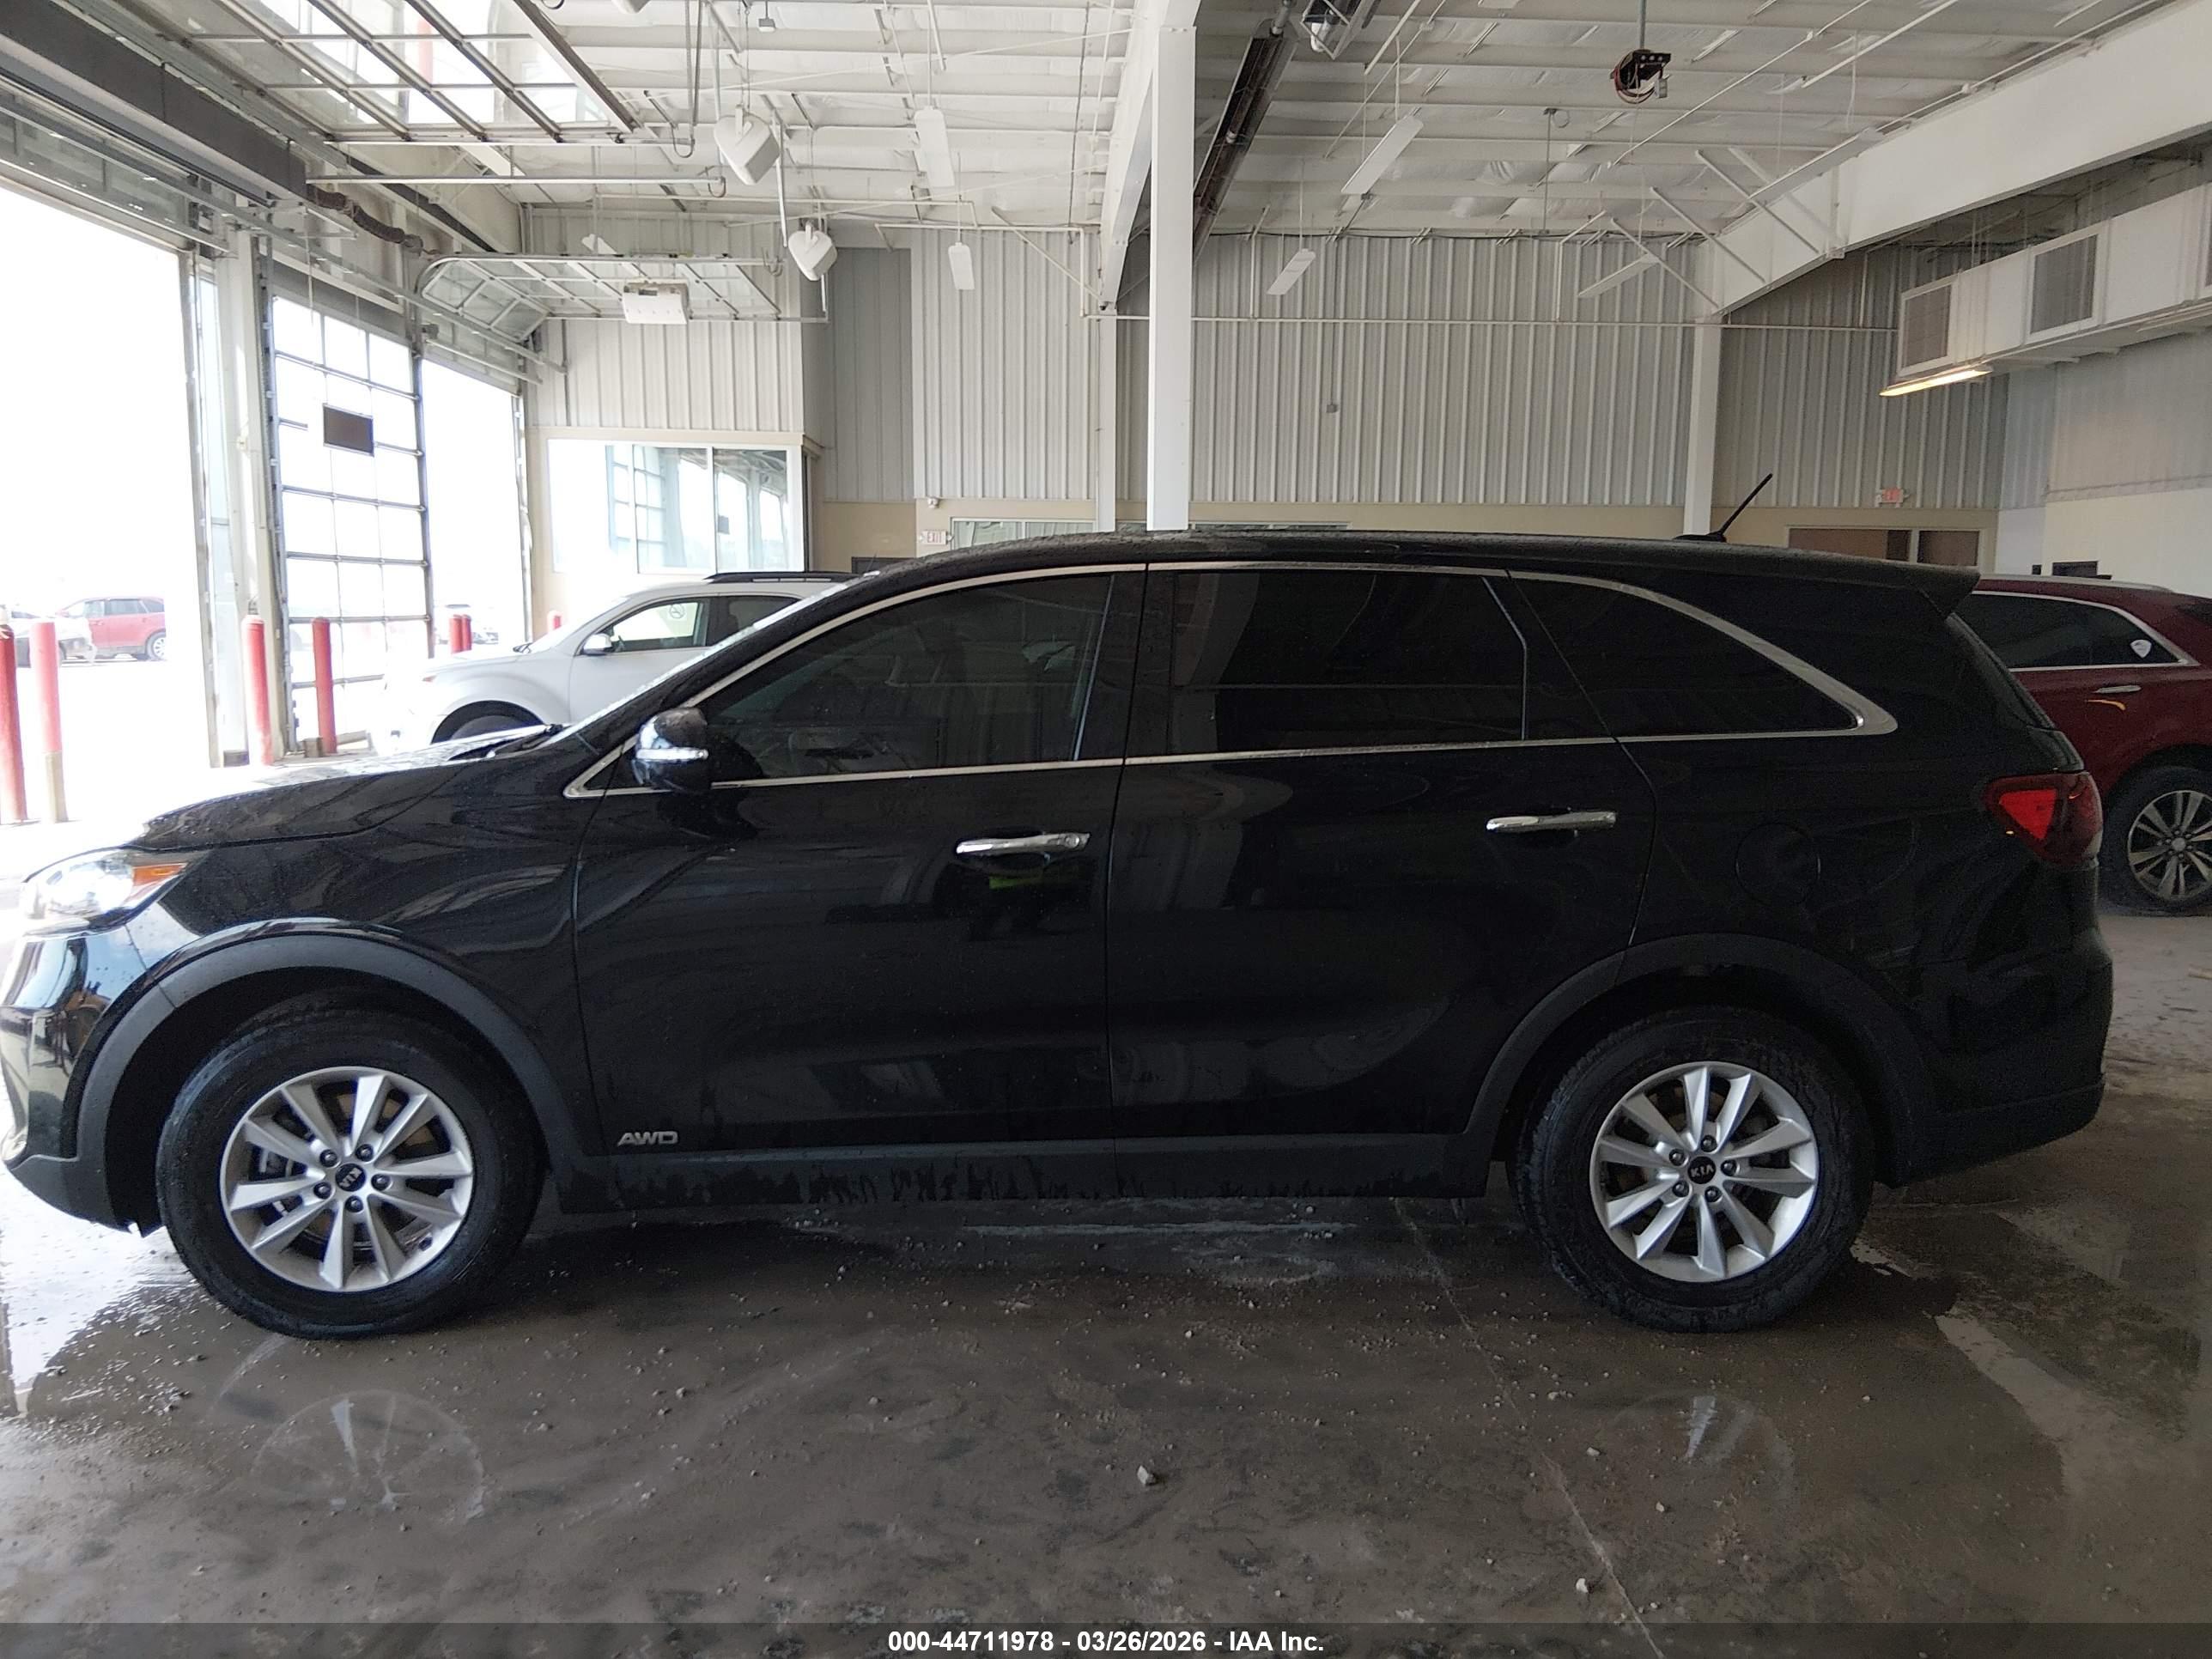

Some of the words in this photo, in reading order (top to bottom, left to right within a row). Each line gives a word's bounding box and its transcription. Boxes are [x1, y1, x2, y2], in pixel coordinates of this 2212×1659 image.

[927, 532, 942, 544] EXIT
[617, 1130, 678, 1146] AWD
[1690, 1164, 1714, 1177] KIA
